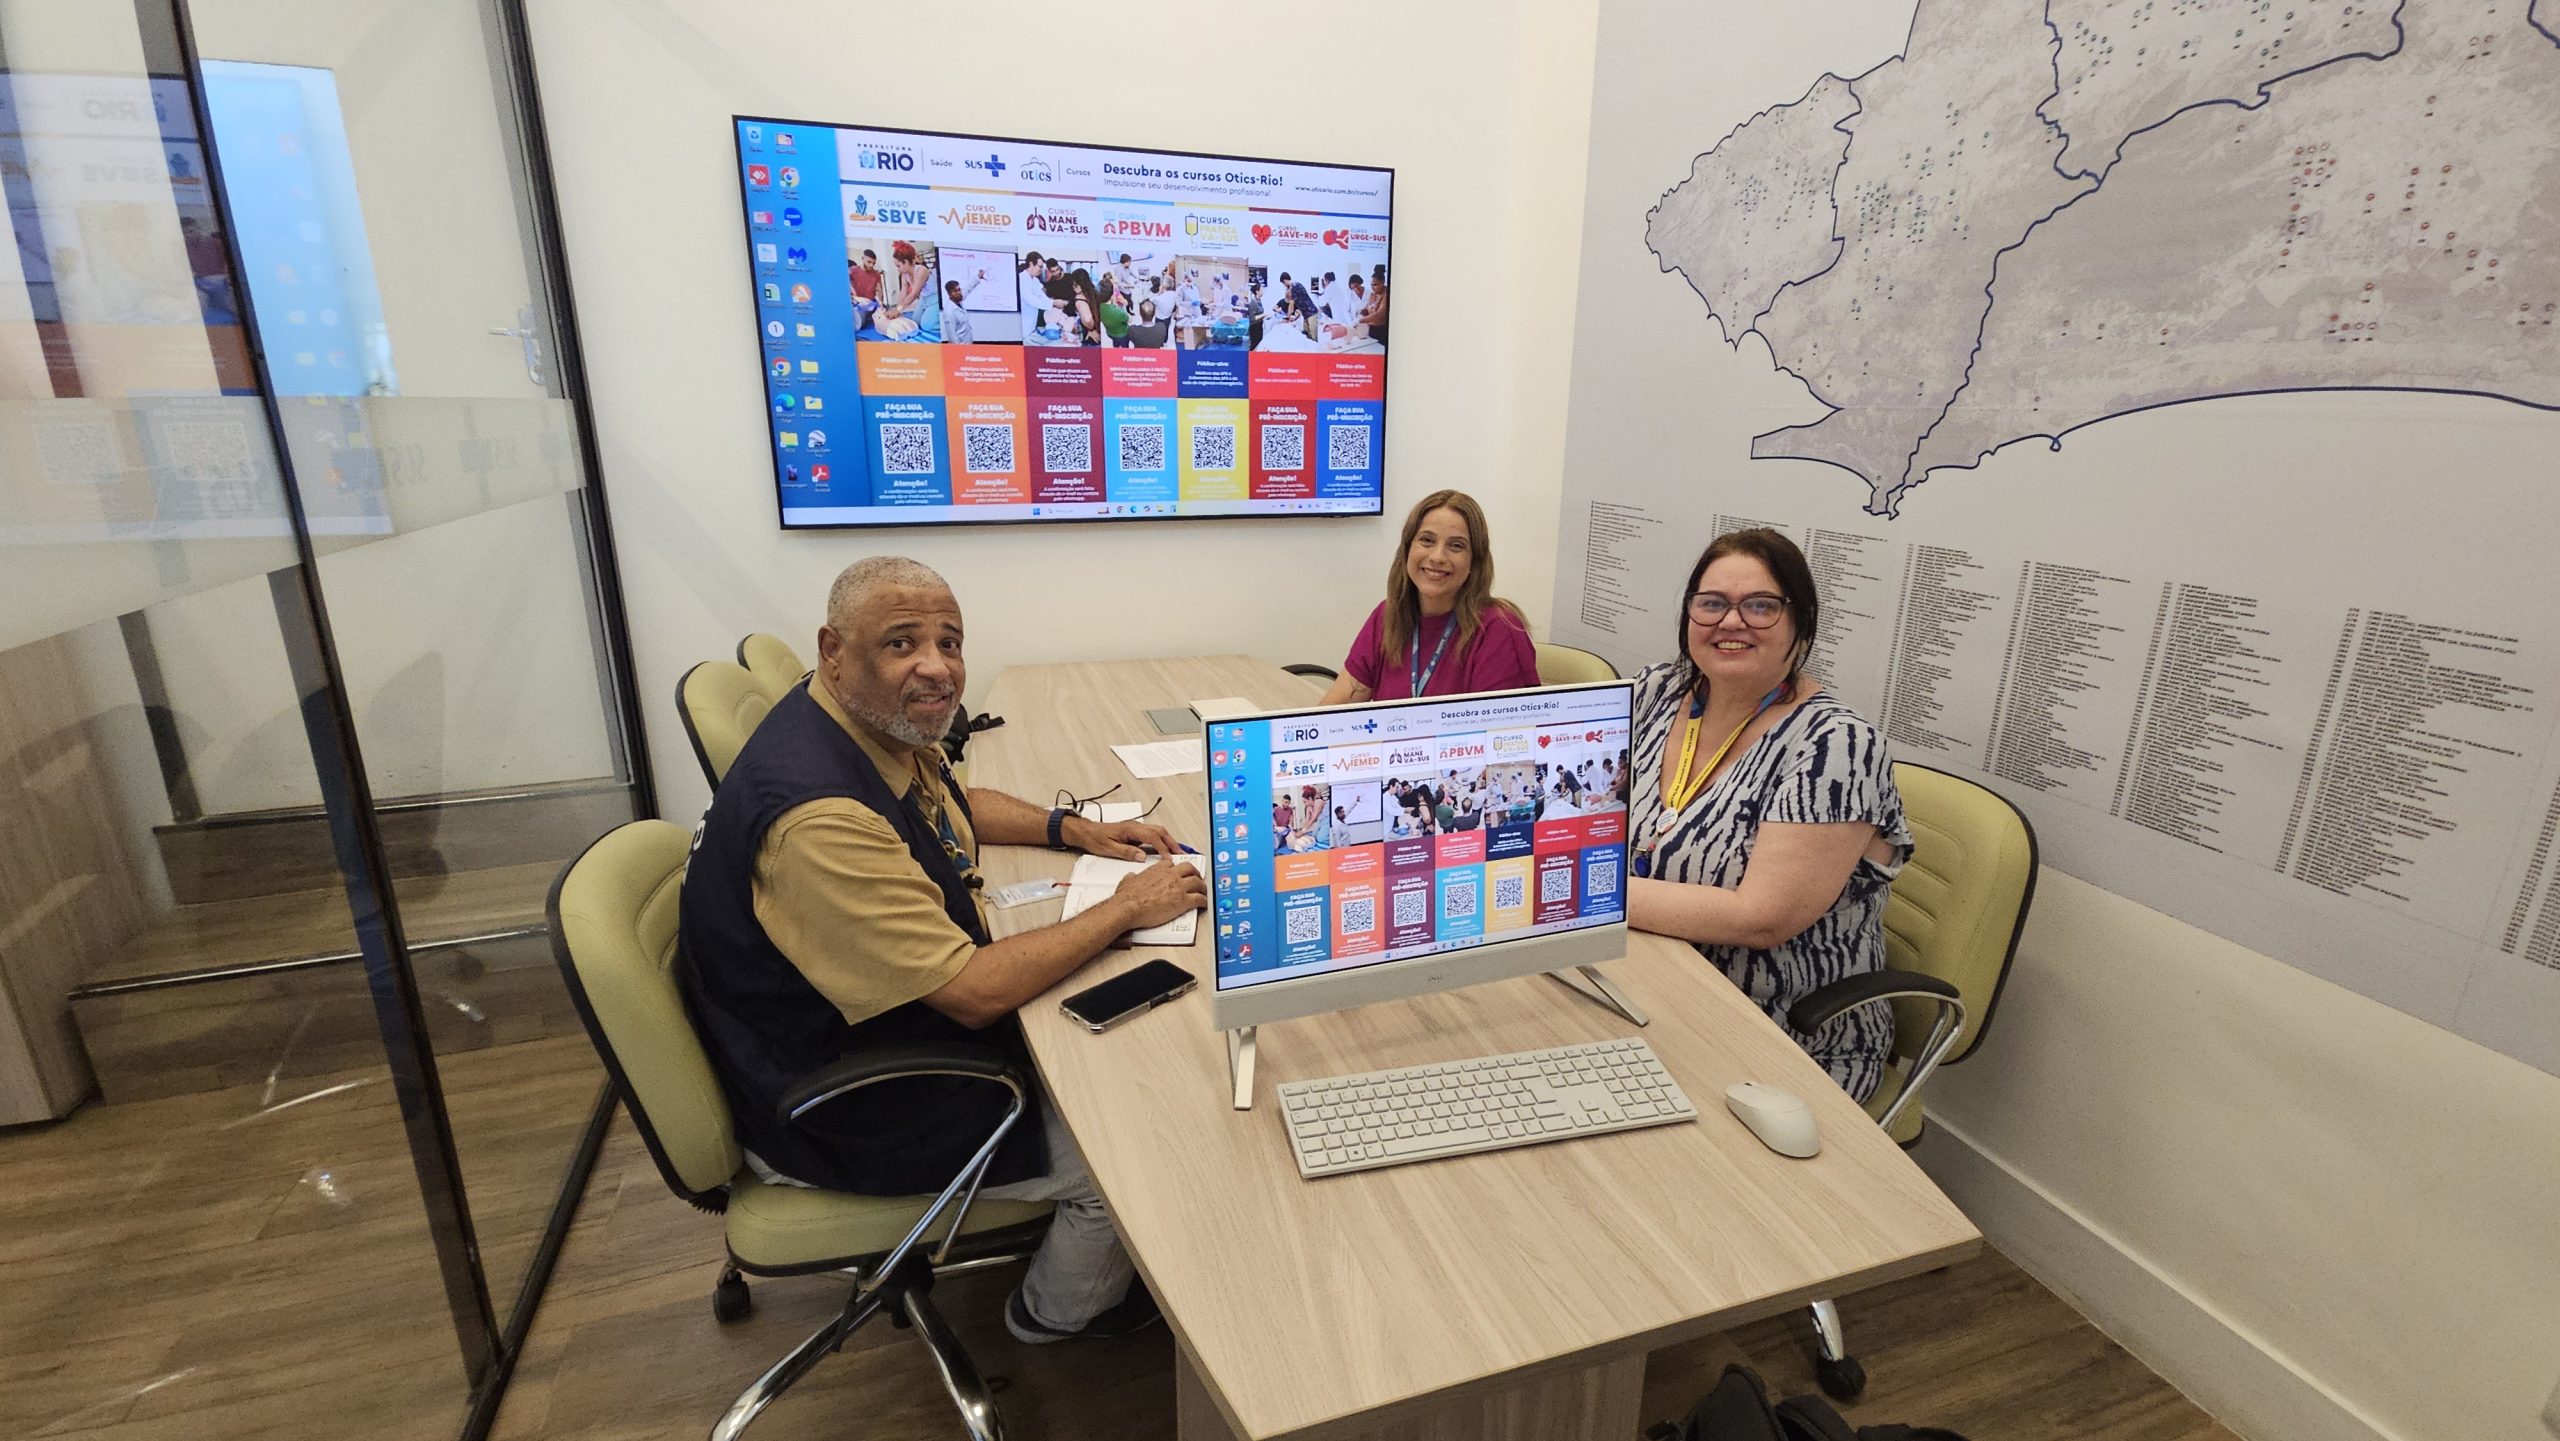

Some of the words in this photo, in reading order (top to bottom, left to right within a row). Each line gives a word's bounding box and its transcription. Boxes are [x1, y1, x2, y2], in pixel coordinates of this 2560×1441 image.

[857, 143, 912, 152] PREFEITURA
[877, 152, 914, 172] RIO
[930, 158, 952, 168] Saúde
[964, 160, 983, 170] SUS
[1020, 169, 1052, 182] otics
[1066, 168, 1091, 176] Cursos
[1104, 163, 1162, 178] Descubra
[1166, 170, 1178, 179] os
[1183, 172, 1221, 182] cursos
[1224, 172, 1283, 186] Otics-Rio!
[1104, 178, 1146, 189] Impulsione
[1148, 182, 1162, 190] seu
[1163, 182, 1228, 194] desenvolvimento
[1229, 187, 1271, 197] profissional
[877, 200, 908, 208] CURSO
[965, 204, 996, 213] CURSO
[1048, 208, 1076, 216] CURSO
[1118, 212, 1146, 220] CURSO
[877, 208, 927, 226] SBVE
[1048, 216, 1078, 225] MANE
[1200, 216, 1230, 225] CURSO
[1049, 224, 1089, 234] VA-SUS
[1118, 220, 1172, 238] PBVM
[1278, 229, 1318, 240] SAVE-RIO
[1350, 233, 1386, 242] URGE-SUS
[885, 404, 906, 412] FAÇA
[1048, 404, 1068, 413] FAÇA
[1268, 406, 1285, 414] FAÇA
[1335, 406, 1352, 414] FAÇA
[1052, 477, 1084, 486] Atenção!
[1268, 475, 1297, 484] Atenção!
[1334, 474, 1362, 482] Atenção!
[893, 478, 928, 488] Atenção!
[975, 478, 1008, 488] Atenção!
[1440, 710, 1478, 719] Descubra
[1492, 706, 1518, 714] cursos
[1520, 701, 1560, 712] Otics-Rio!
[1295, 728, 1319, 742] RIO
[1449, 745, 1484, 758] PBVM
[1404, 756, 1430, 764] VA-SUS
[1294, 764, 1324, 776] SBVE
